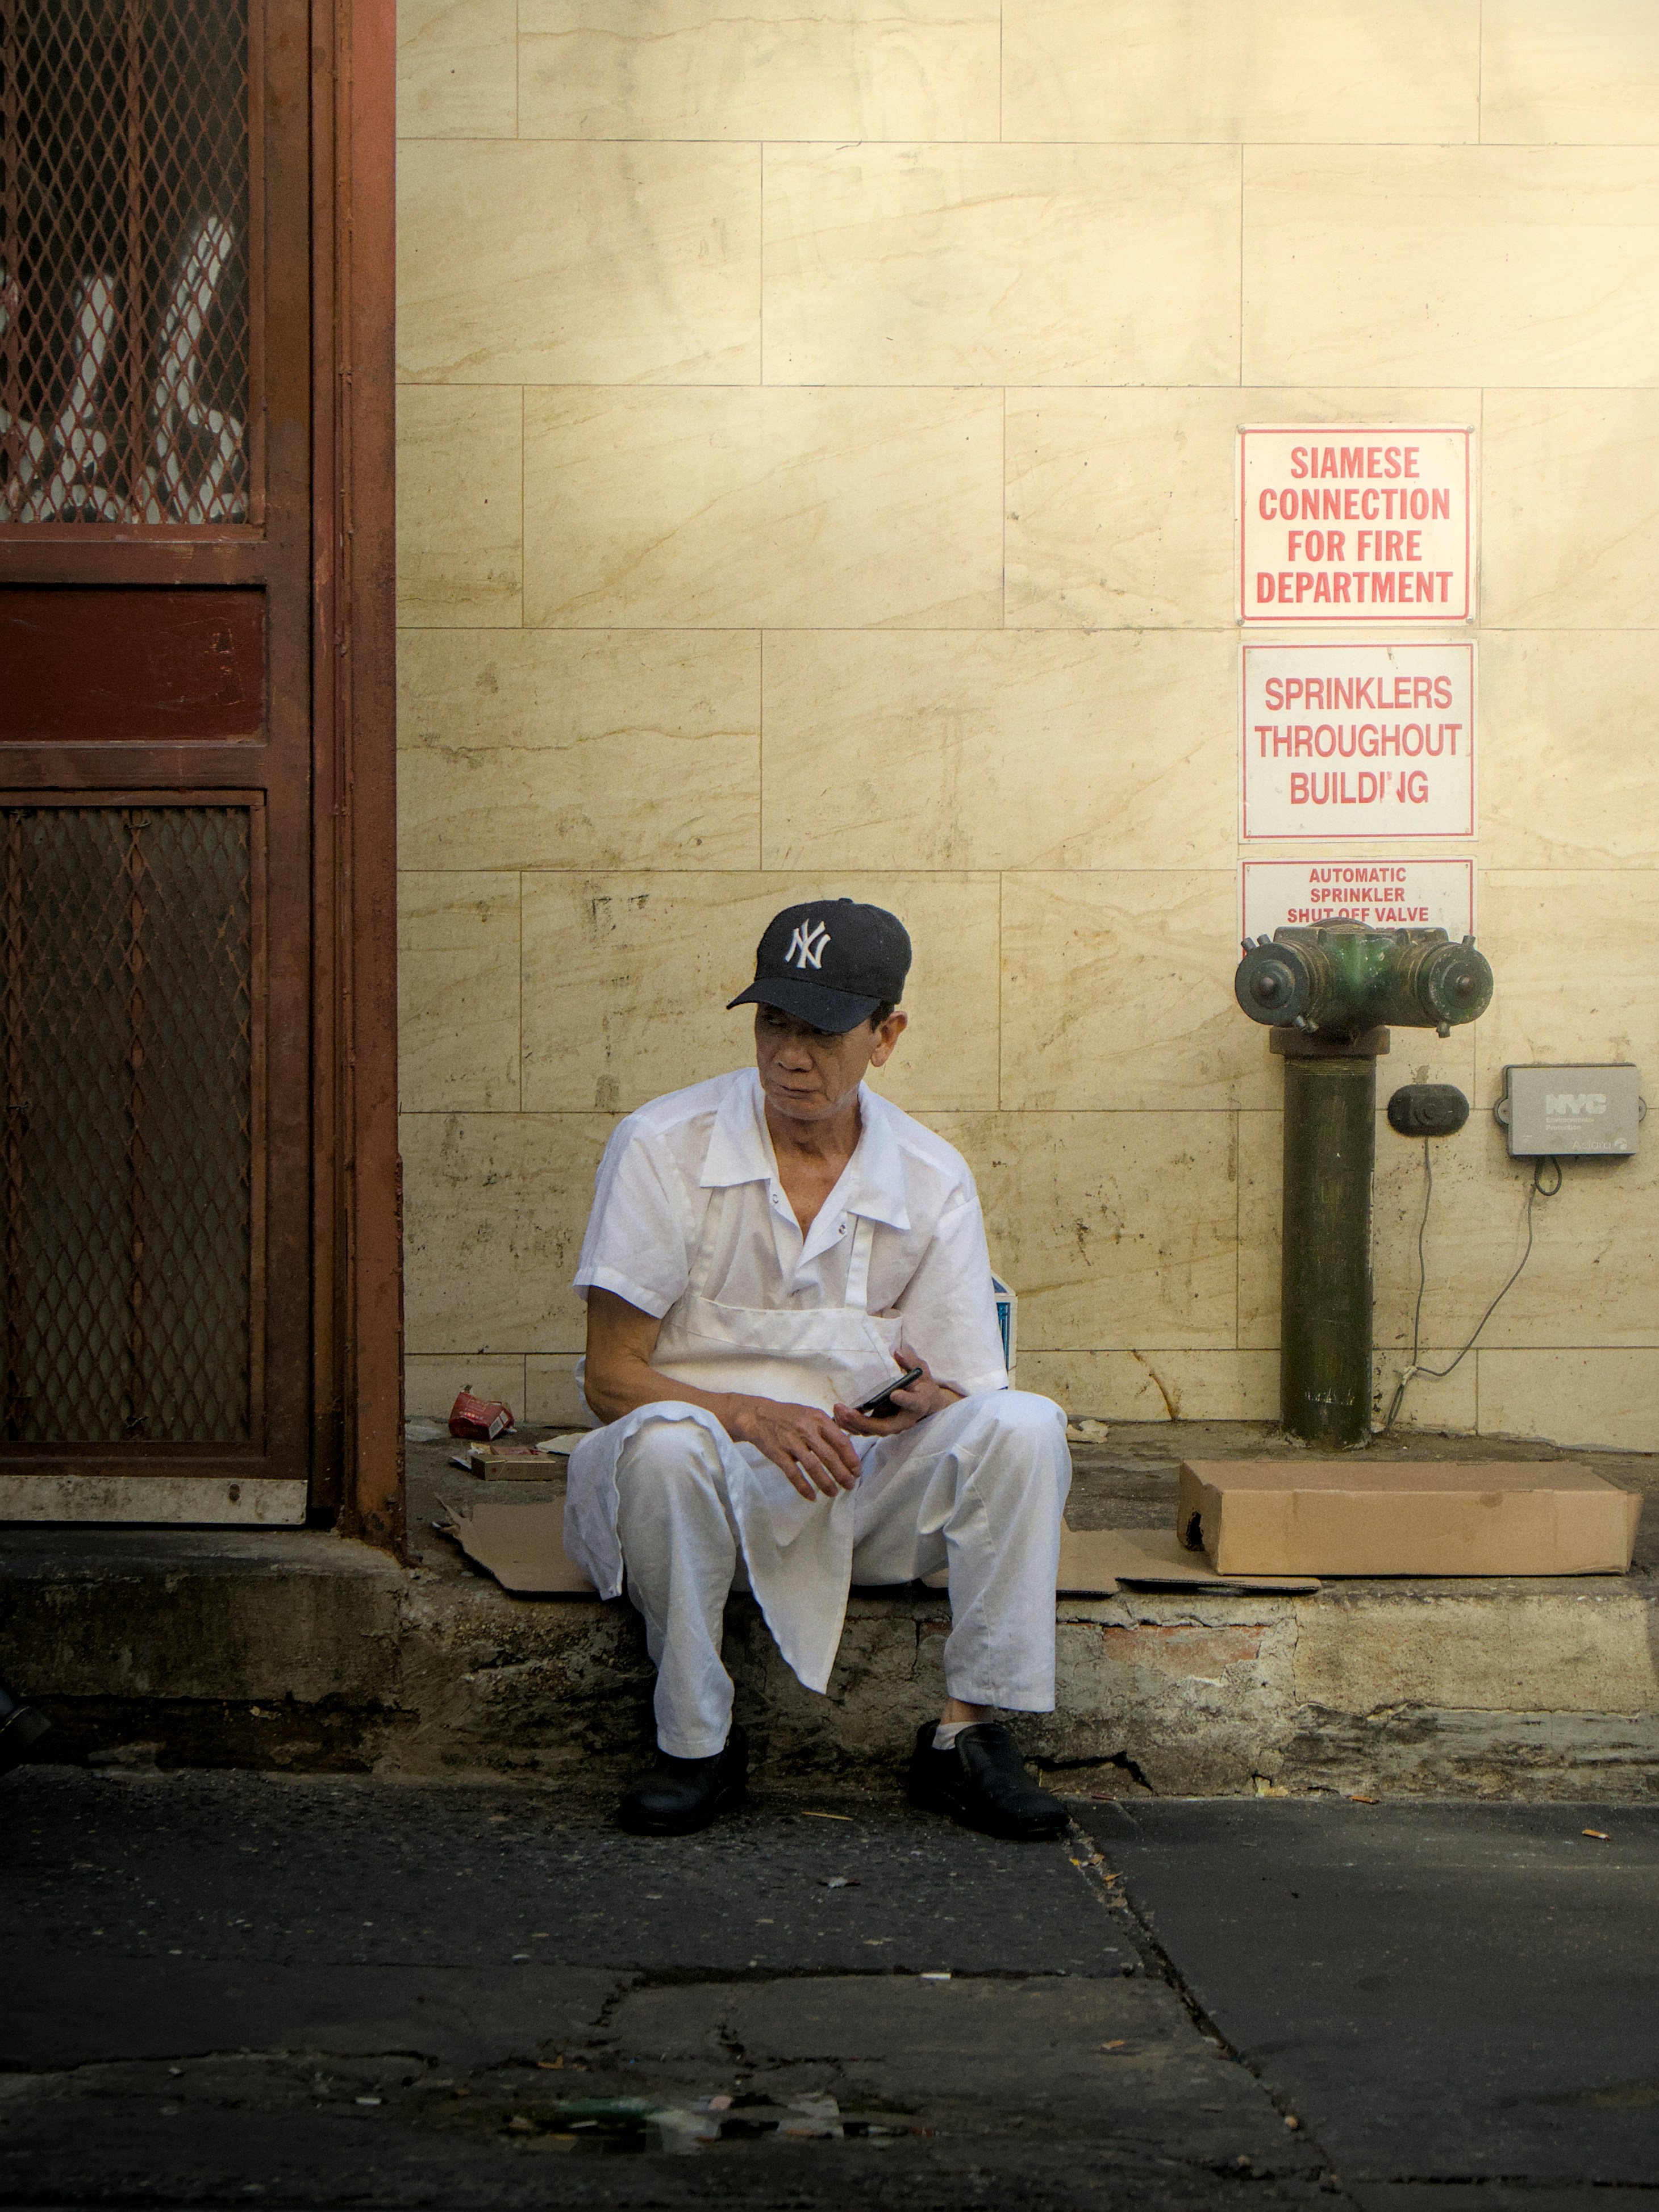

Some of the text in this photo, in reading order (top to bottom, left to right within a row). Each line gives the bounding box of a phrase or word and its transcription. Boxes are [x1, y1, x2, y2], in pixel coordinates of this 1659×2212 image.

[1290, 446, 1420, 478] SIAMESE
[1258, 488, 1450, 520] CONNECTION
[1288, 530, 1422, 562] FOR FIRE
[1256, 571, 1453, 603] DEPARTMENT
[1265, 676, 1453, 711] SPRINKLERS
[1254, 723, 1462, 758] THROUGHOUT
[1309, 867, 1406, 883] AUTOMATIC
[1310, 887, 1405, 903] SPRINKLER
[1287, 907, 1429, 923] SHUT OFF VALVE
[783, 918, 831, 970] NY
[1546, 1093, 1607, 1115] NYC
